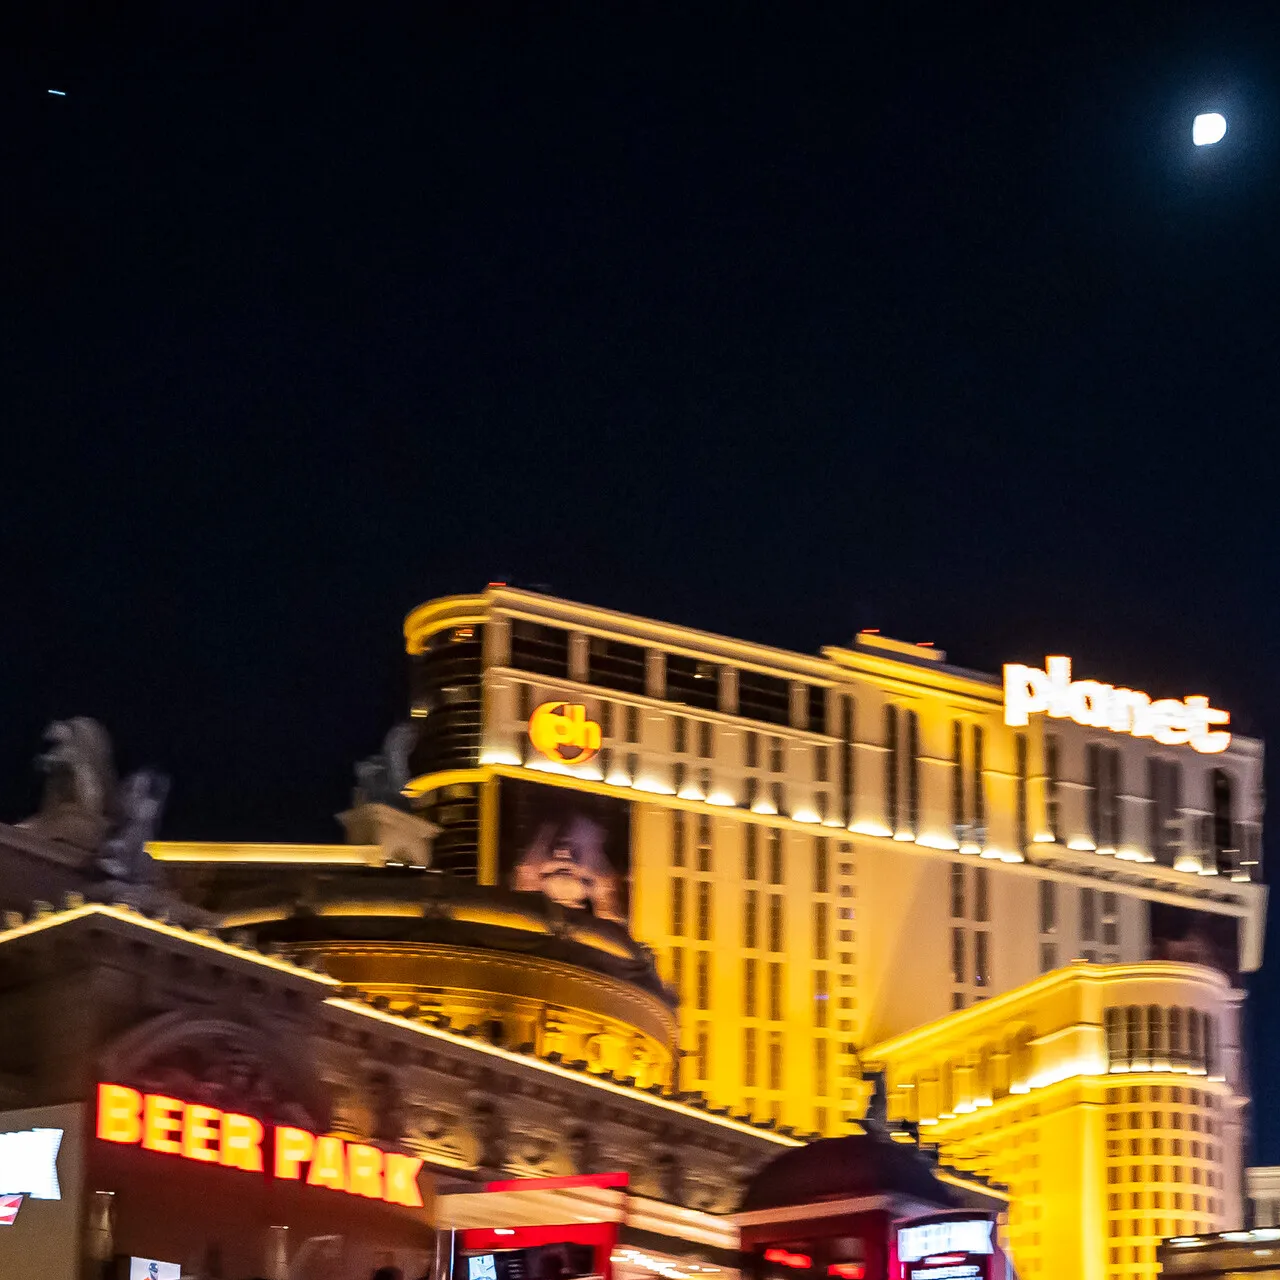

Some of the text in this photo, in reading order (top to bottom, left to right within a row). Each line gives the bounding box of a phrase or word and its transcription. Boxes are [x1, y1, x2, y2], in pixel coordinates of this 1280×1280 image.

[1002, 654, 1232, 754] planet
[95, 1083, 425, 1208] BEER PARK
